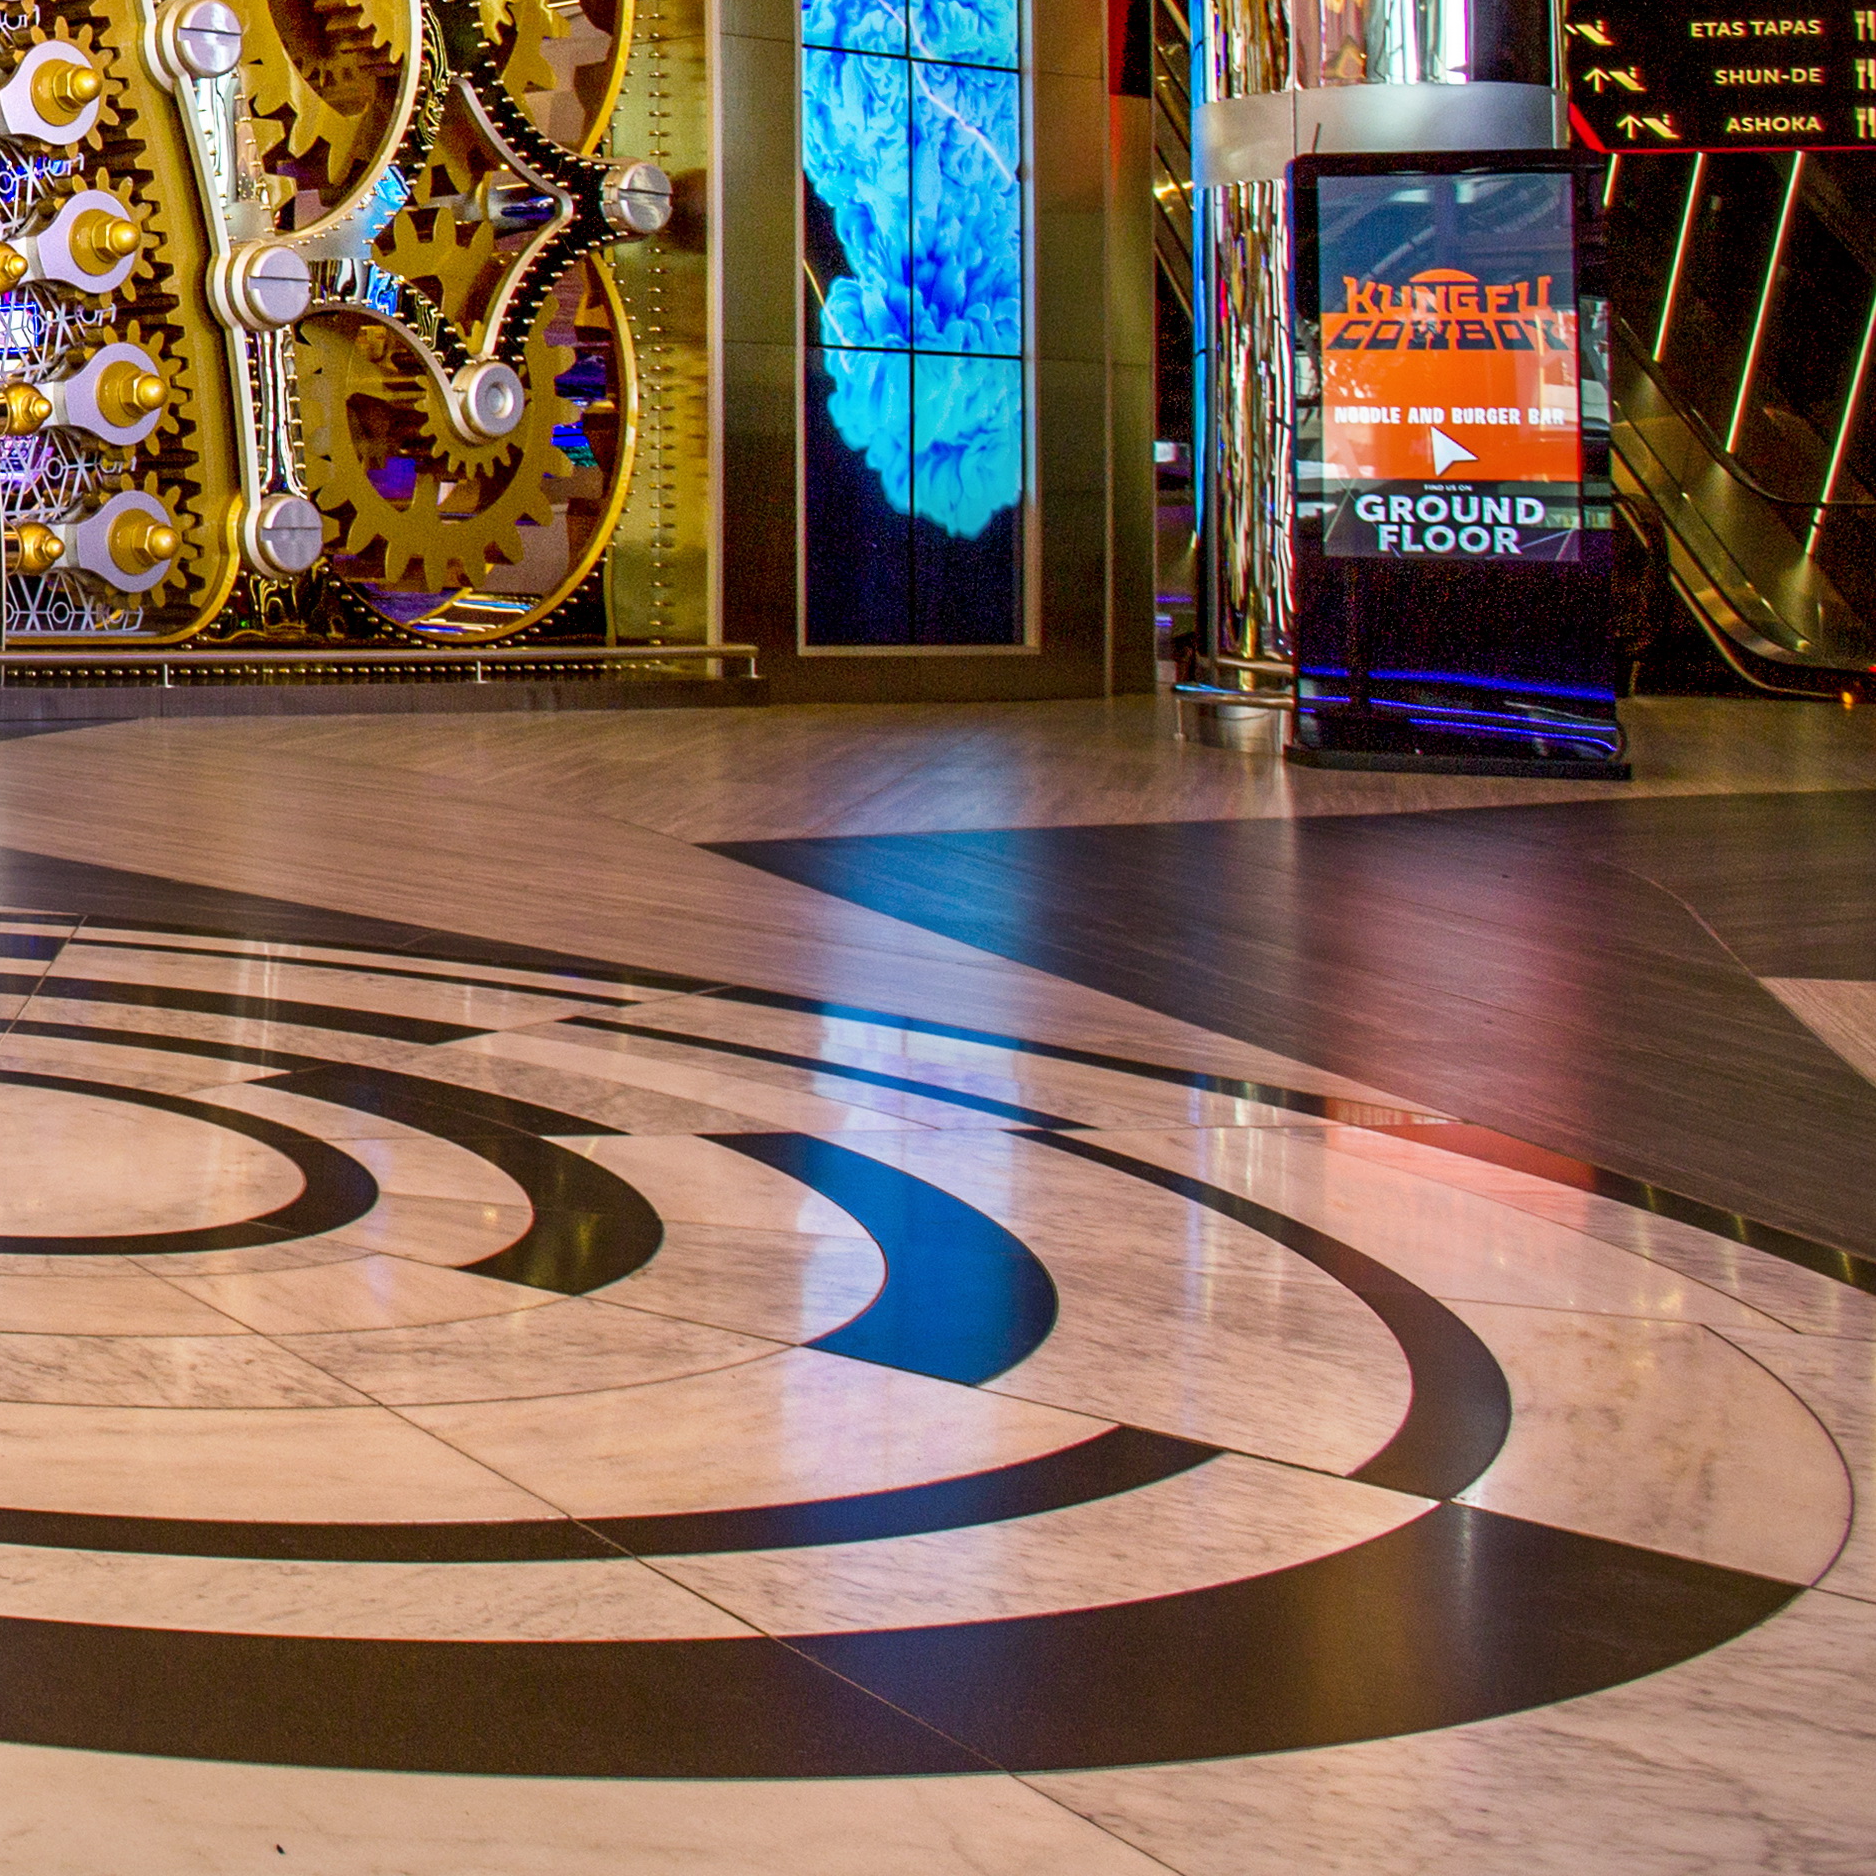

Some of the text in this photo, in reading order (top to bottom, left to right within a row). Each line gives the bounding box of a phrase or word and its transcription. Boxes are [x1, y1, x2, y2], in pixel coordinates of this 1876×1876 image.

[1690, 19, 1823, 37] ETAS TAPAS
[1714, 67, 1824, 84] SHUN-DE
[1726, 116, 1824, 132] ASHOKA
[1343, 275, 1553, 314] KUNG FU
[1327, 319, 1569, 350] COWBOY
[1334, 406, 1565, 425] NOODLE AND BURGER BAR
[1354, 493, 1546, 524] GROUND
[1377, 524, 1523, 555] FLOOR
